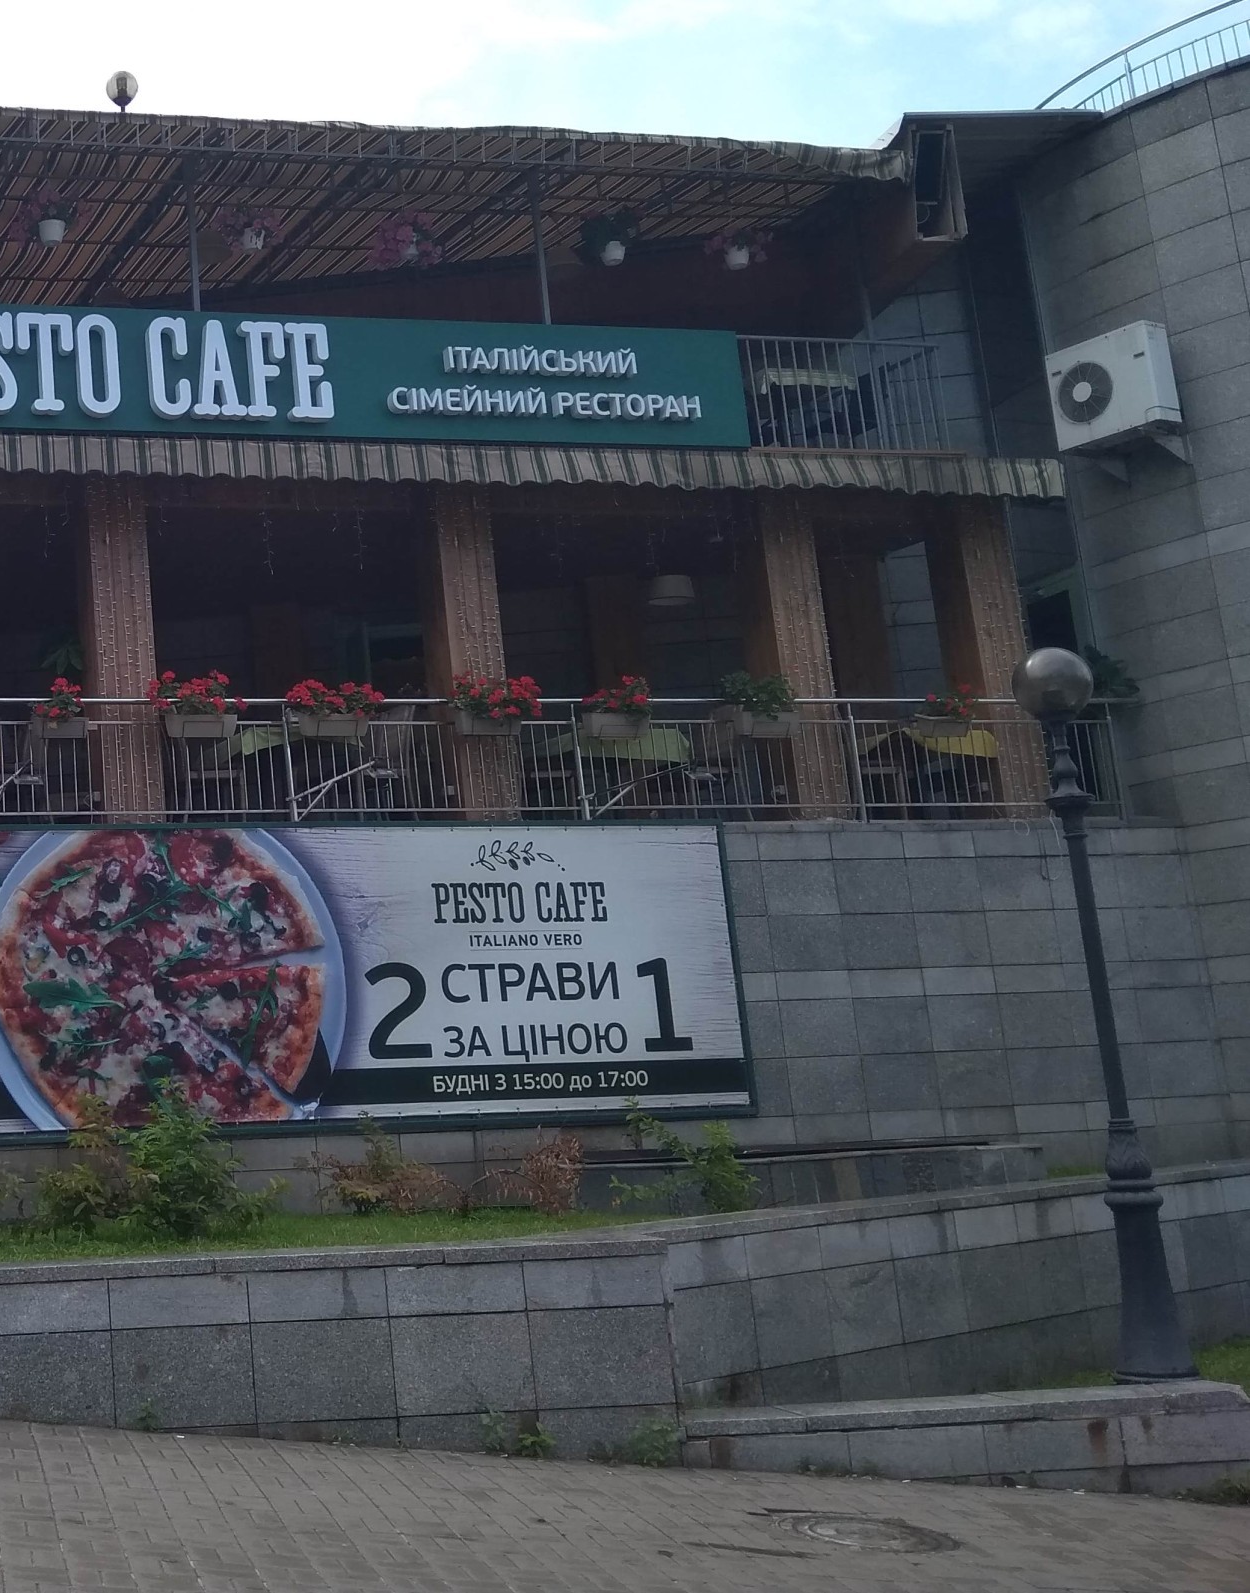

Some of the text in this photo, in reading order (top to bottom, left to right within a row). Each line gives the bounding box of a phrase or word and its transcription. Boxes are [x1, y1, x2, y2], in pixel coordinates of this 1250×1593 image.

[145, 316, 335, 423] CAFE
[443, 344, 638, 378] ІТАЛІЙСЬКИЙ
[387, 384, 702, 421] СІМЕЙНИЙ РЕСТОРАН
[431, 881, 608, 924] PESTO CAFE
[469, 932, 583, 948] ITALIANO VERO
[441, 961, 620, 1003] СТРАВИ
[364, 962, 433, 1060] 2
[636, 957, 694, 1053] 1
[443, 1022, 628, 1063] ЗА ЦІНОЮ
[432, 1074, 490, 1095] БУДНІ
[512, 1073, 565, 1091] 15:00
[569, 1074, 592, 1092] до
[597, 1070, 649, 1088] 17:00
